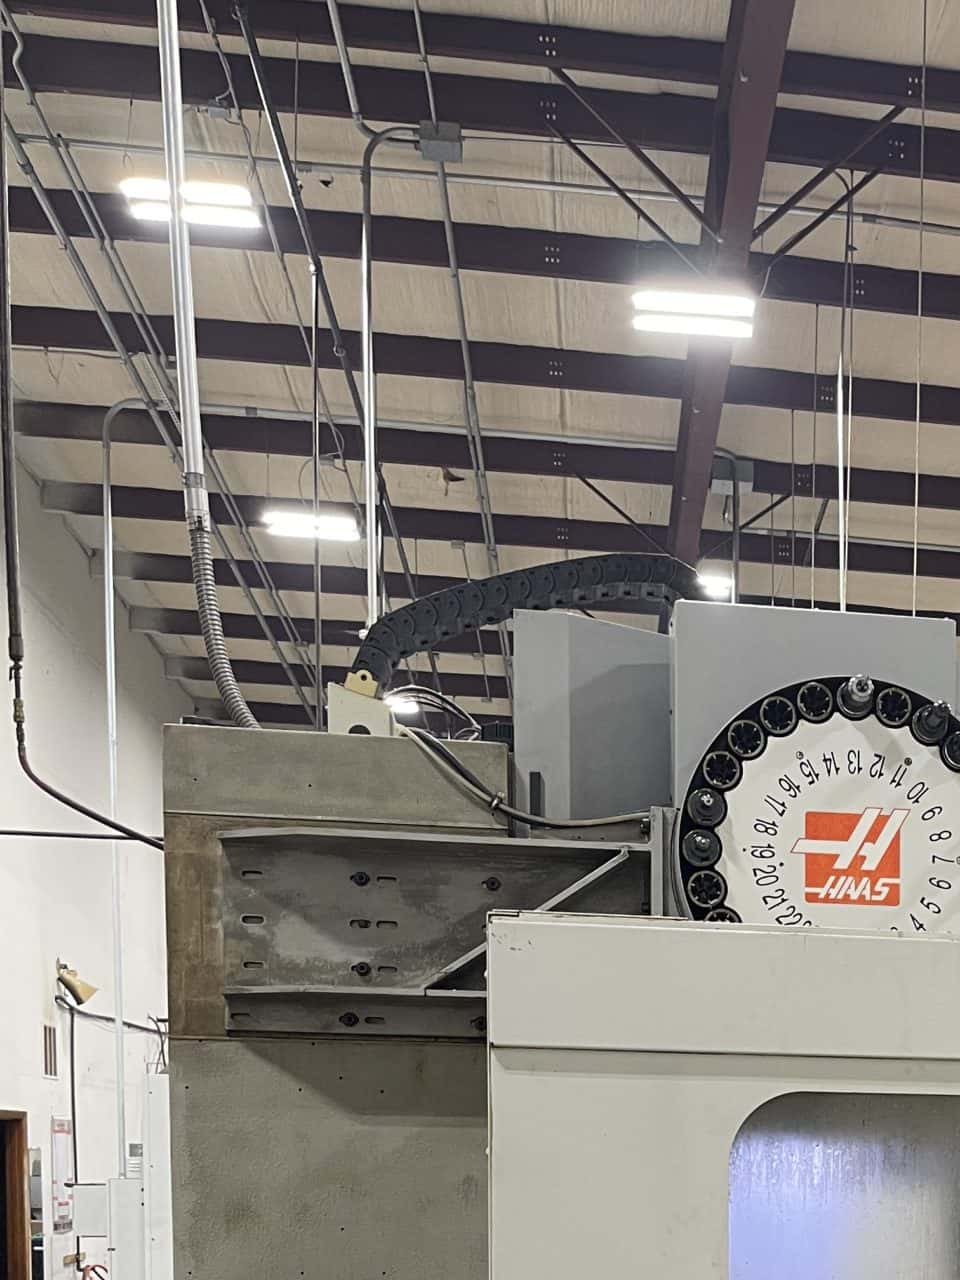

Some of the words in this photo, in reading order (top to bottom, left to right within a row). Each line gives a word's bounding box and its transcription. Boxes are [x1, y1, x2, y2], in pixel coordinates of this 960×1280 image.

[799, 759, 820, 786] 15
[822, 751, 841, 777] 14
[847, 749, 863, 775] 13
[869, 753, 886, 779] 12
[778, 774, 802, 798] 16
[889, 764, 908, 788] 11
[906, 781, 929, 804] 10
[763, 794, 788, 817] 17
[921, 806, 943, 821] 9
[753, 818, 779, 837] 18
[929, 830, 952, 842] 8
[750, 843, 776, 859] 19
[931, 854, 955, 864] 7
[752, 864, 779, 887] 20
[928, 876, 952, 890] 6
[761, 888, 790, 911] 21
[818, 875, 891, 901] HAAS
[919, 896, 942, 914] 5
[909, 913, 927, 932] 4
